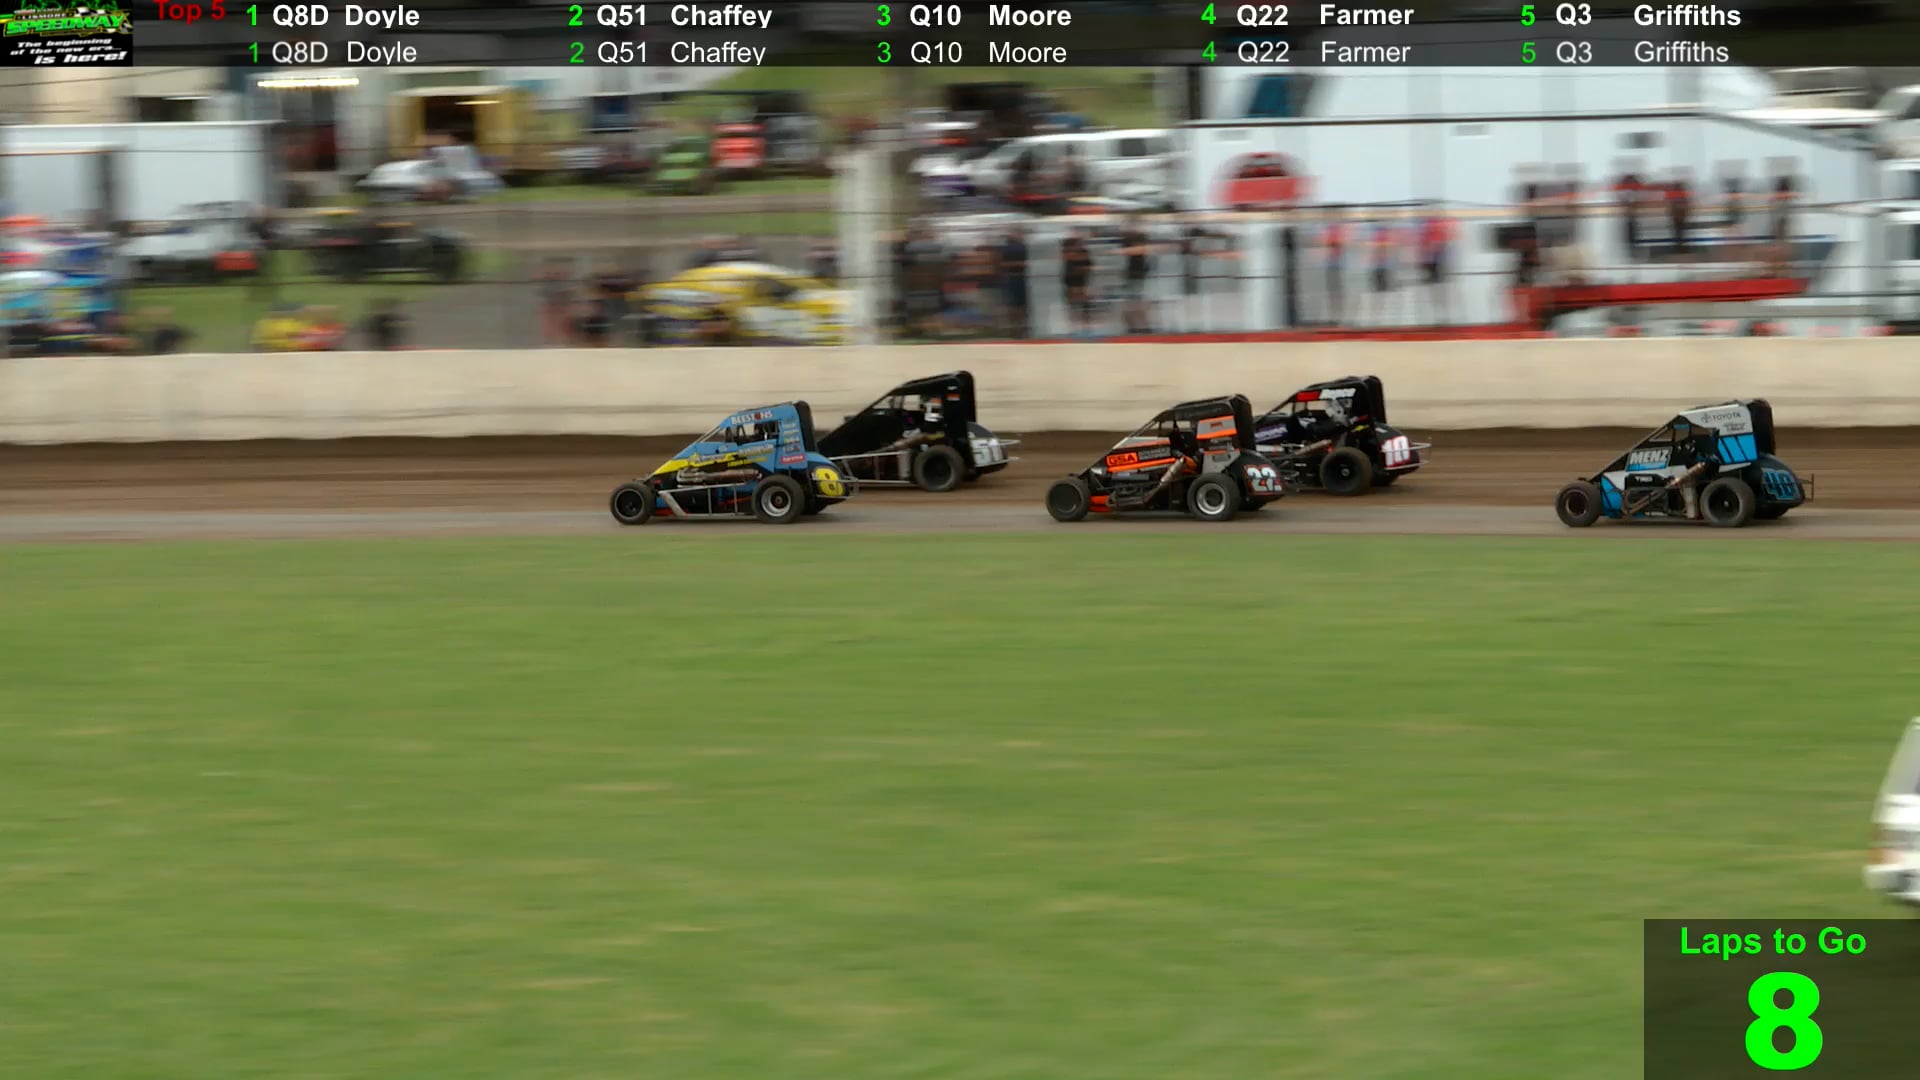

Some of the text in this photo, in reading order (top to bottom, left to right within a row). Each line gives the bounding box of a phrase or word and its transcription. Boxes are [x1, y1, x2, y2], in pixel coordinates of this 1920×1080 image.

[1712, 411, 1742, 421] TOYOTA
[1107, 453, 1136, 466] GSA
[1380, 434, 1412, 468] 10
[1629, 449, 1670, 466] MENZ
[1244, 464, 1285, 494] 22
